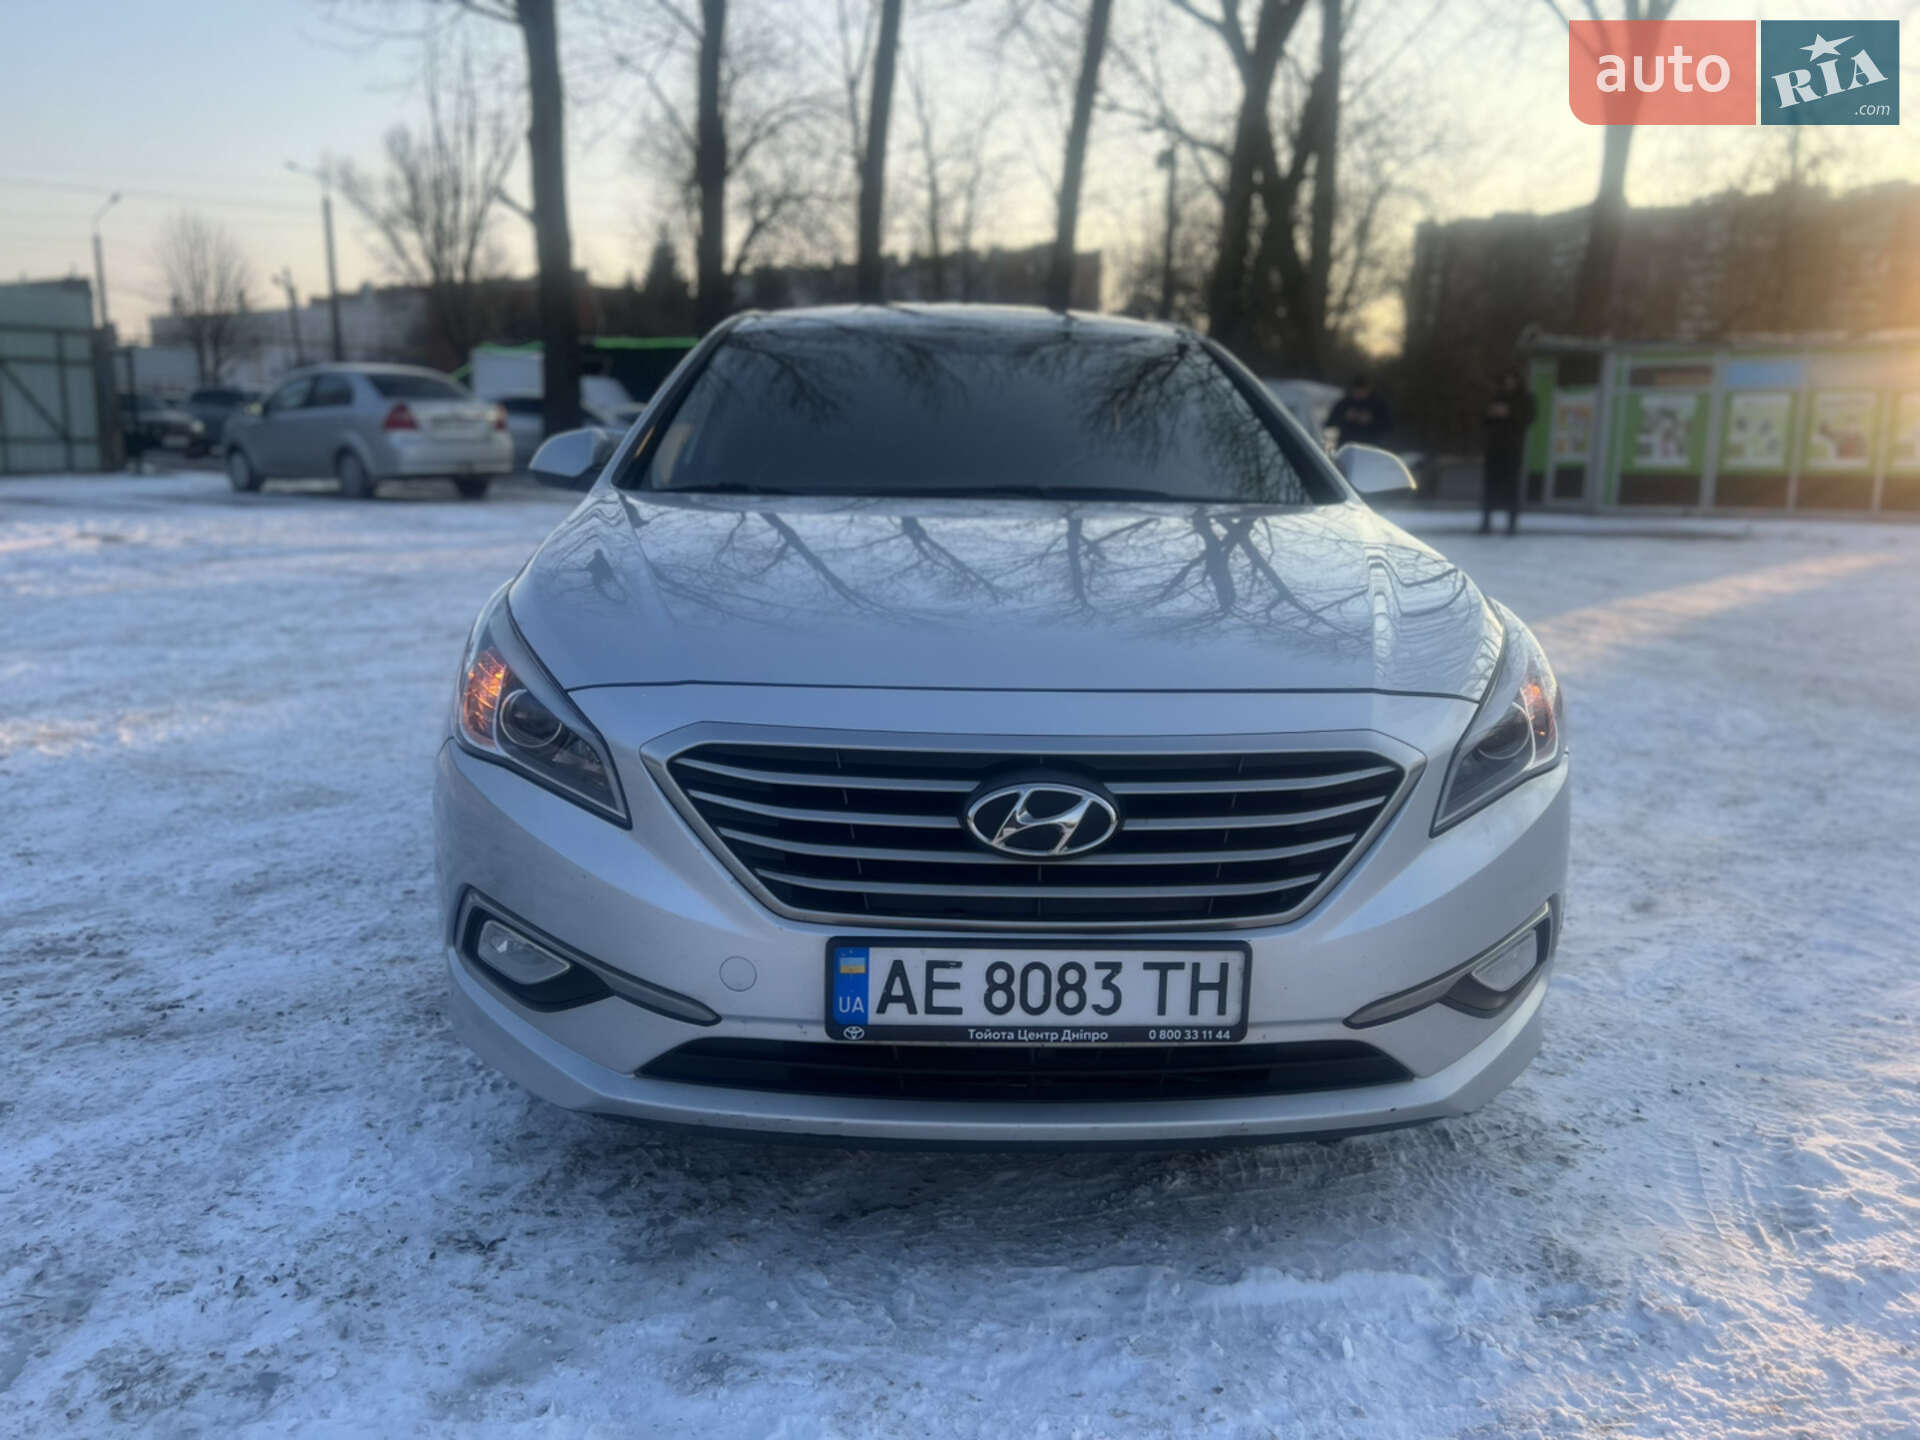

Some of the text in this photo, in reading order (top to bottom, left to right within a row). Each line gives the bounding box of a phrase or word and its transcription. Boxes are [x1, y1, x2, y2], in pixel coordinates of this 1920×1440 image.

[876, 960, 1229, 1016] AE 8083 TH
[839, 996, 865, 1013] UA
[968, 1028, 1109, 1042] Тойота Центр Дніпро
[1149, 1030, 1231, 1040] 0 800 33 11 44
